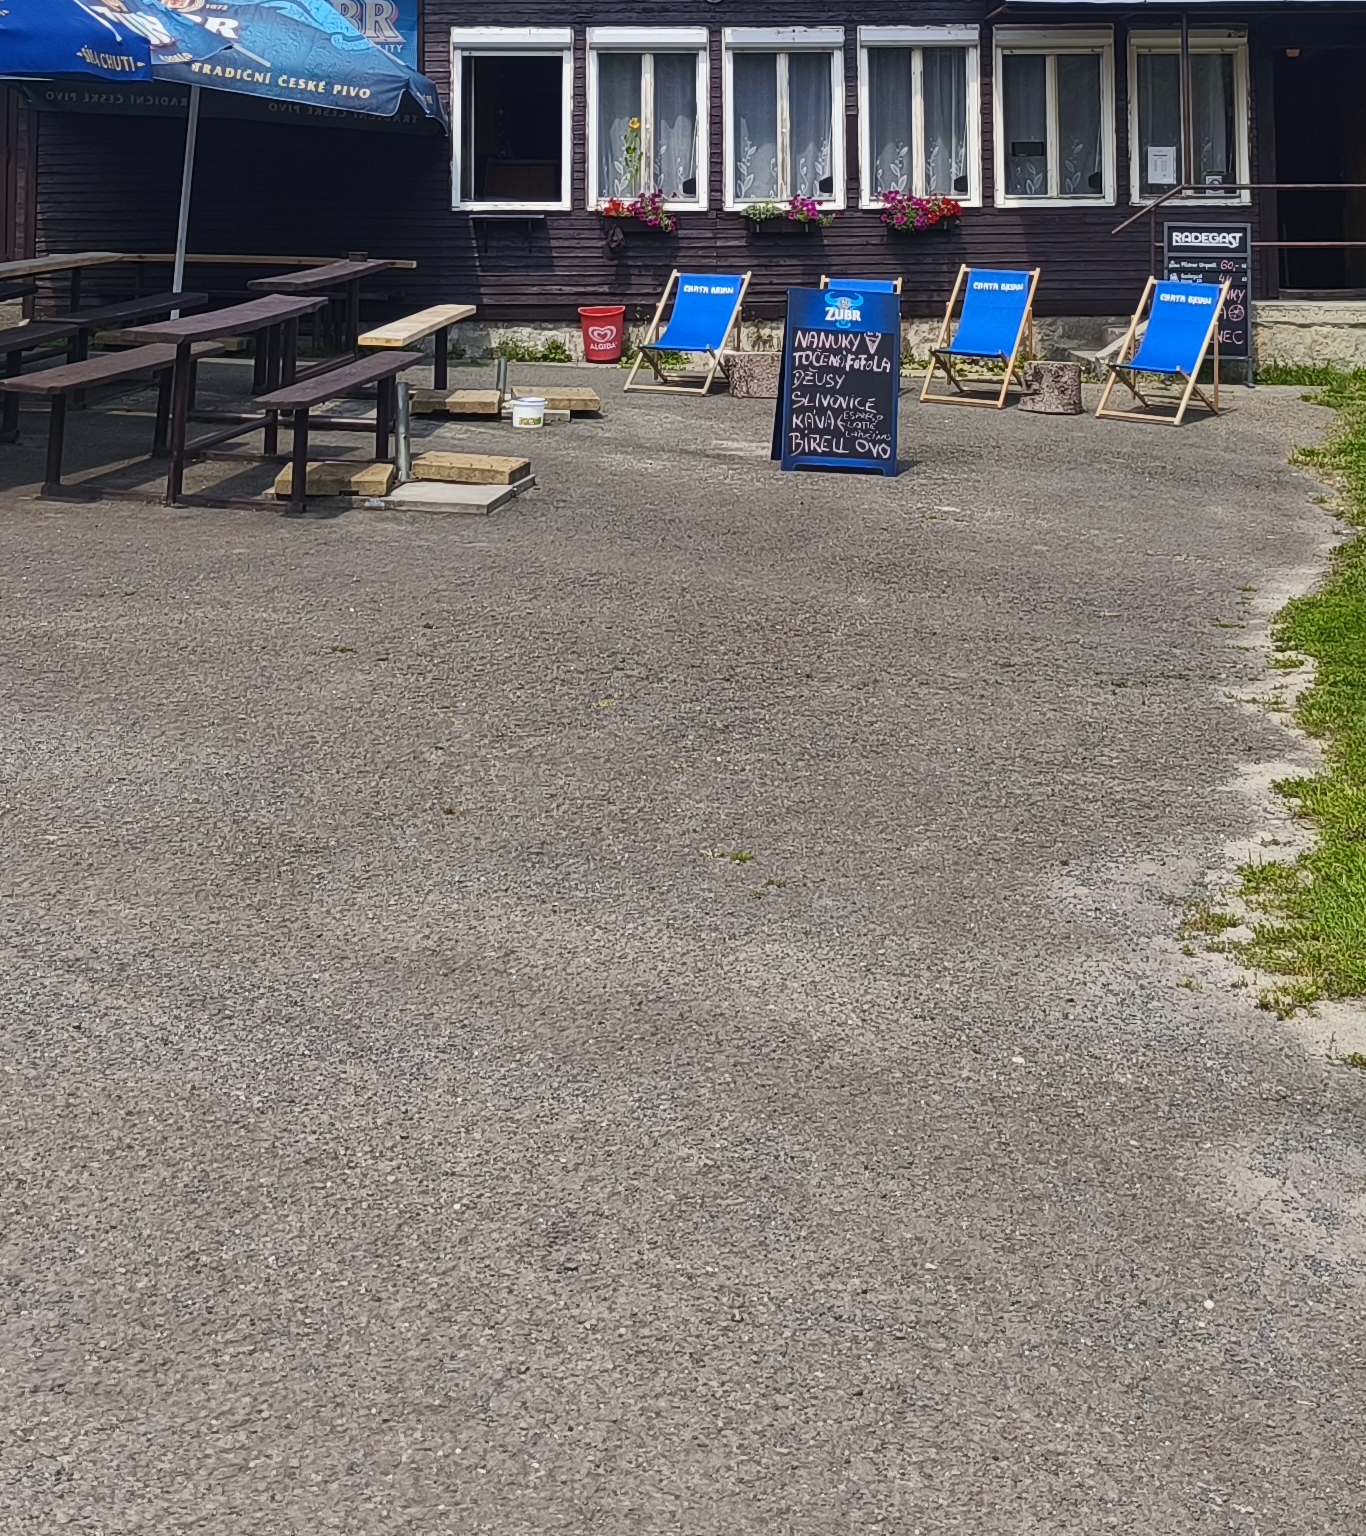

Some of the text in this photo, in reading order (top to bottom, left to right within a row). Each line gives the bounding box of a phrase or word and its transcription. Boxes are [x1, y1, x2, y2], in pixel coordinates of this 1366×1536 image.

[99, 54, 135, 72] CHUTI
[191, 61, 371, 99] TRADIČNÍ ČESKÉ PIVO
[1172, 231, 1243, 248] RADEGAST
[825, 307, 861, 321] ZUBR
[590, 342, 616, 350] ALGIDA
